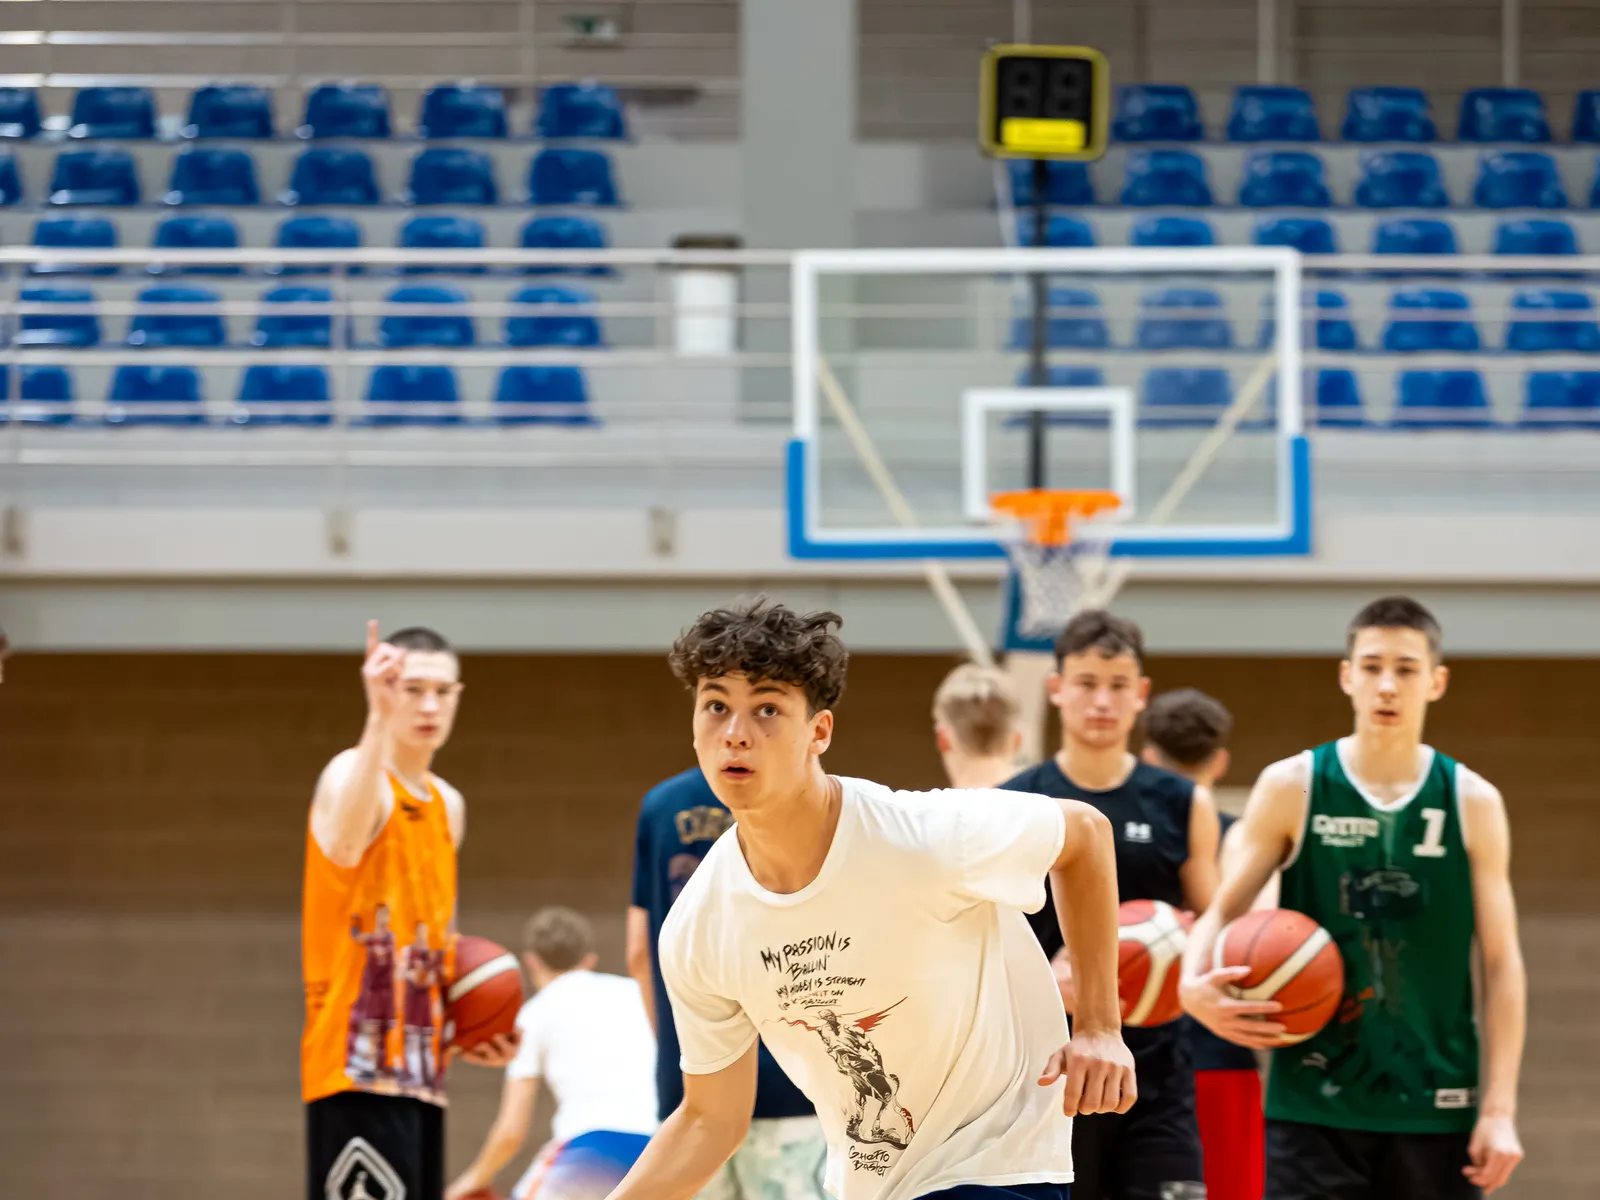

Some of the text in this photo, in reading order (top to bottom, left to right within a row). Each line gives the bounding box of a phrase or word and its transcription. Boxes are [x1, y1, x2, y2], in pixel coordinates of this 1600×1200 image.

[1412, 807, 1446, 858] 1
[783, 930, 837, 966] PASSION
[838, 937, 852, 952] IS
[814, 977, 823, 989] IS
[825, 976, 866, 987] STRAIGHT
